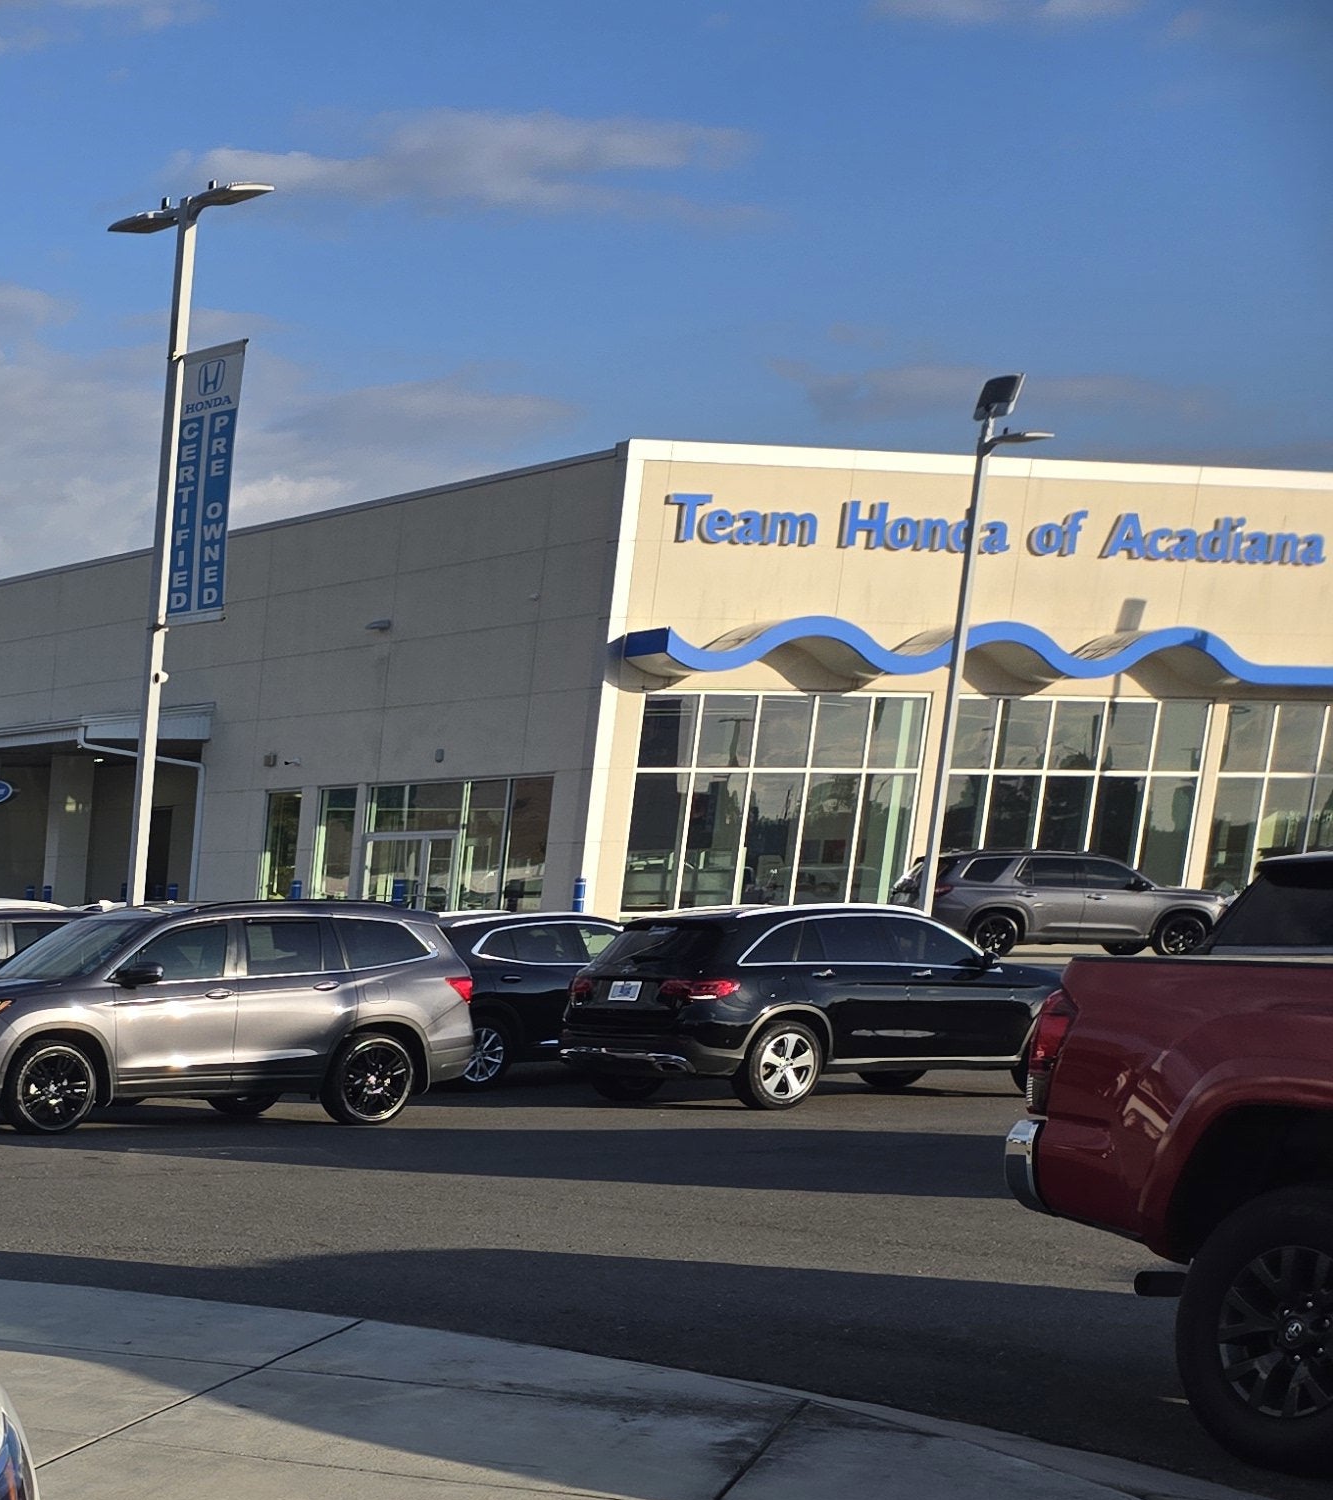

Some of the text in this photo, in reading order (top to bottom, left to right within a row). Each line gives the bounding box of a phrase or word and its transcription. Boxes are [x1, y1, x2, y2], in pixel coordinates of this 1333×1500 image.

[185, 394, 232, 415] HONDA
[170, 422, 200, 610] CERTIFIED
[202, 414, 230, 605] PRE OWNED
[664, 492, 819, 547] Team
[1027, 509, 1090, 558] of
[1098, 512, 1326, 567] Acadiana
